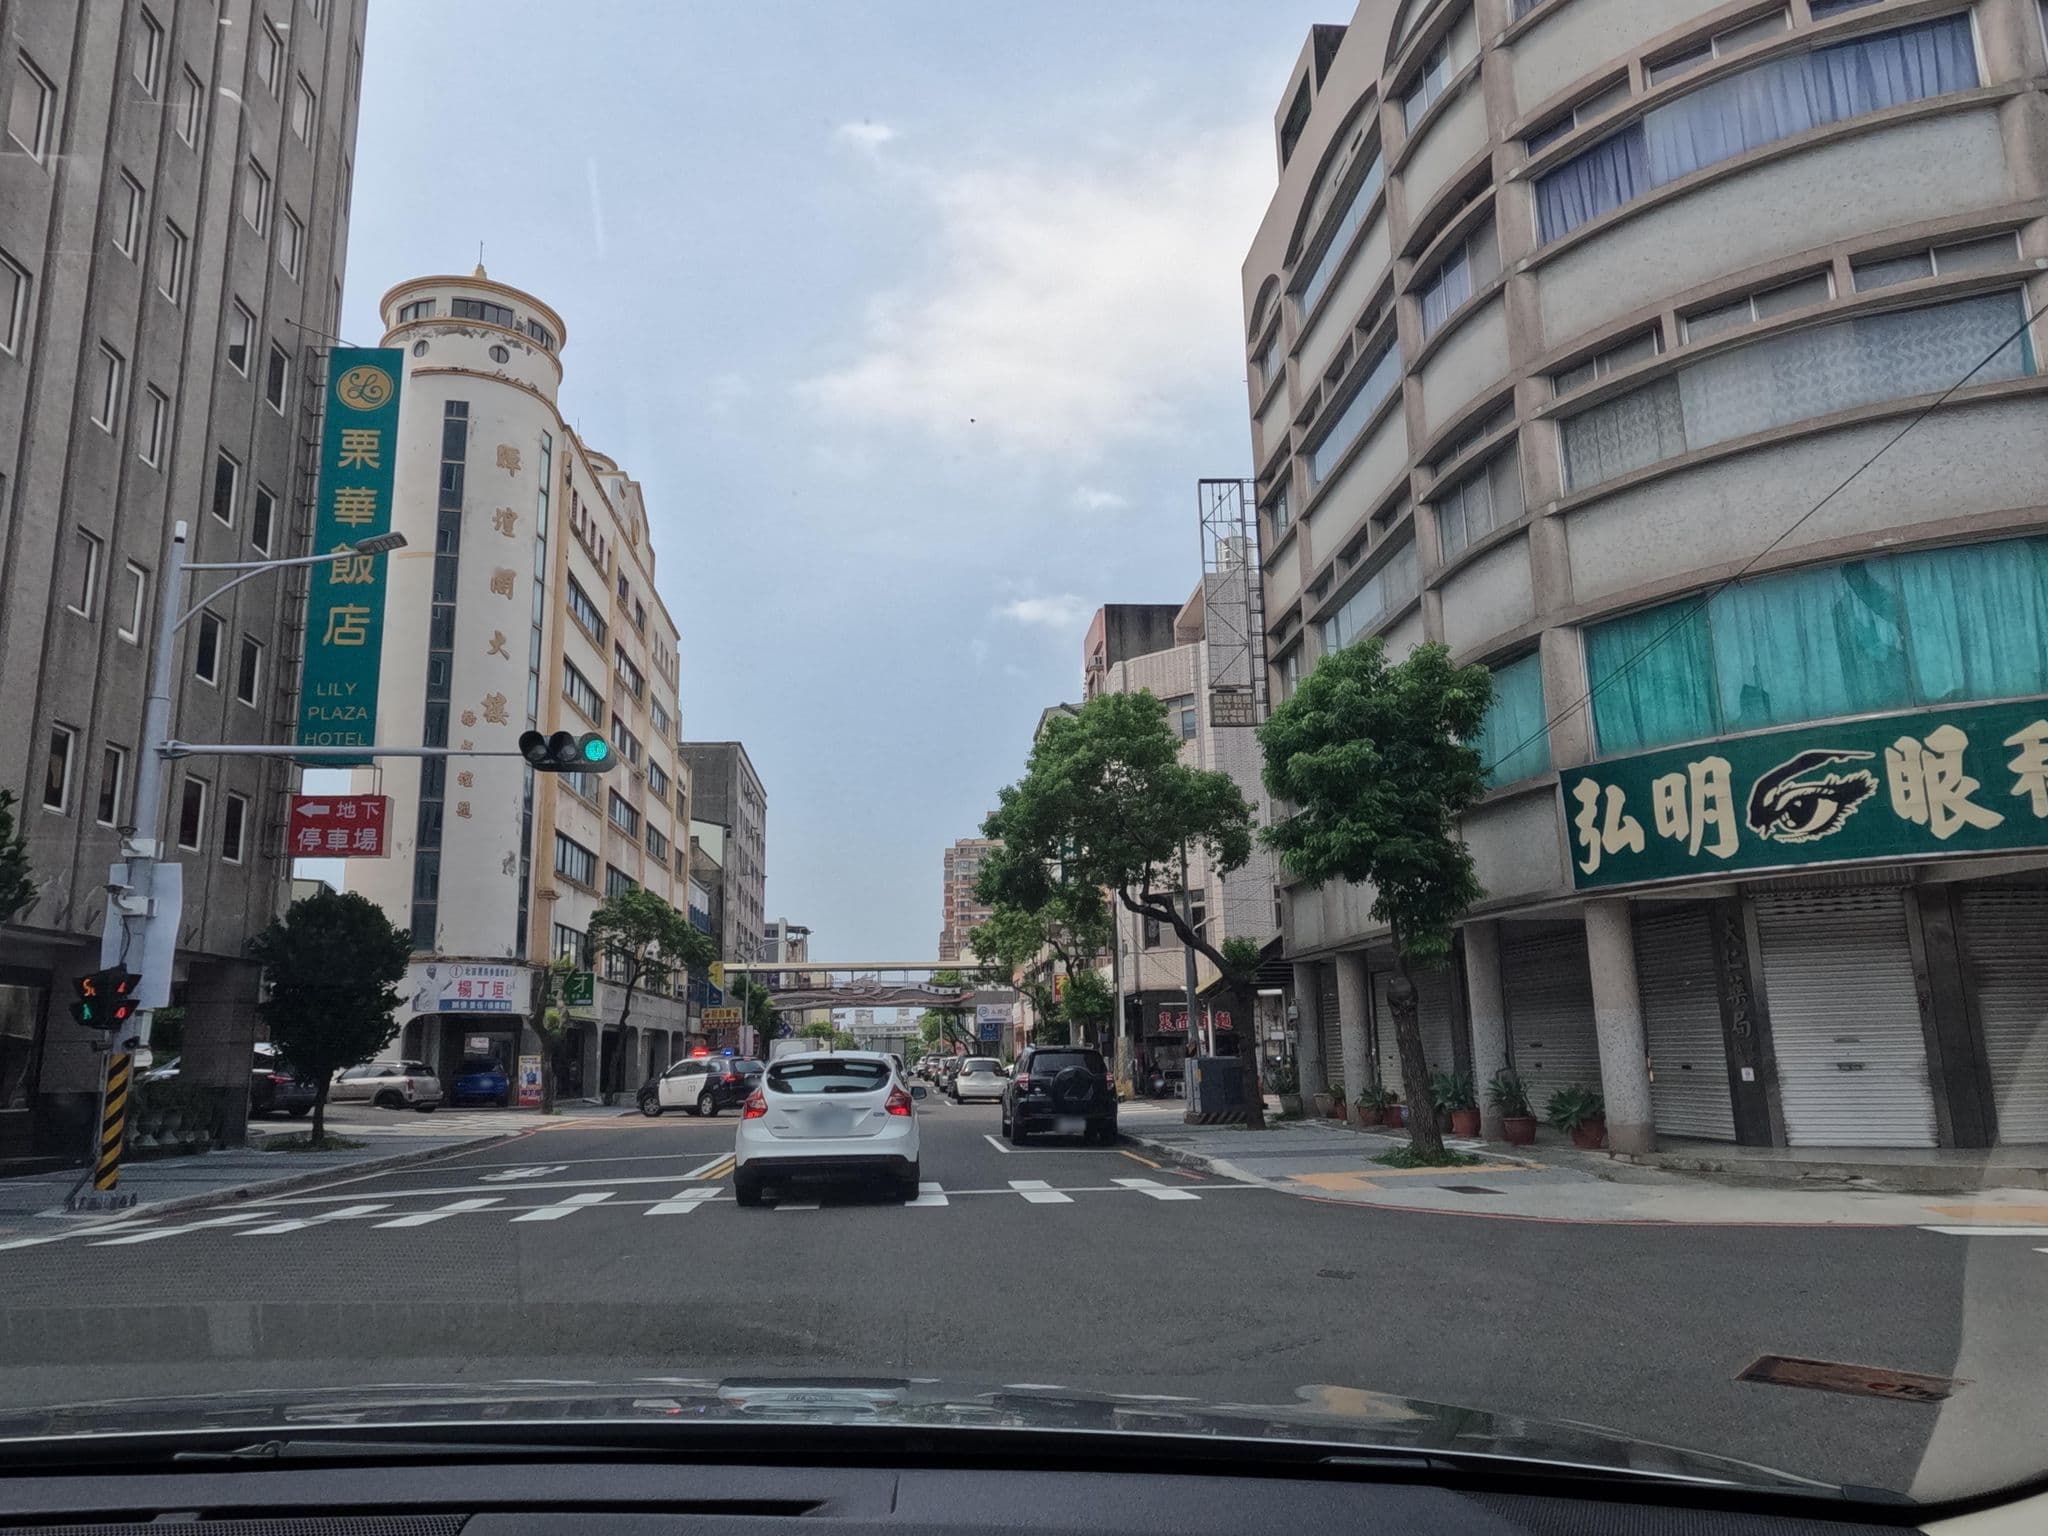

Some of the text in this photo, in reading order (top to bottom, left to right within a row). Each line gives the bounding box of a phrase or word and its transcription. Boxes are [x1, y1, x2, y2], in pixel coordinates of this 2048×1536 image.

[316, 682, 357, 697] LILY
[307, 705, 368, 721] PLAZA
[304, 731, 367, 747] HOTEL
[336, 800, 380, 820] 地下
[1572, 755, 1740, 875] 弘明
[297, 826, 378, 852] 停車場
